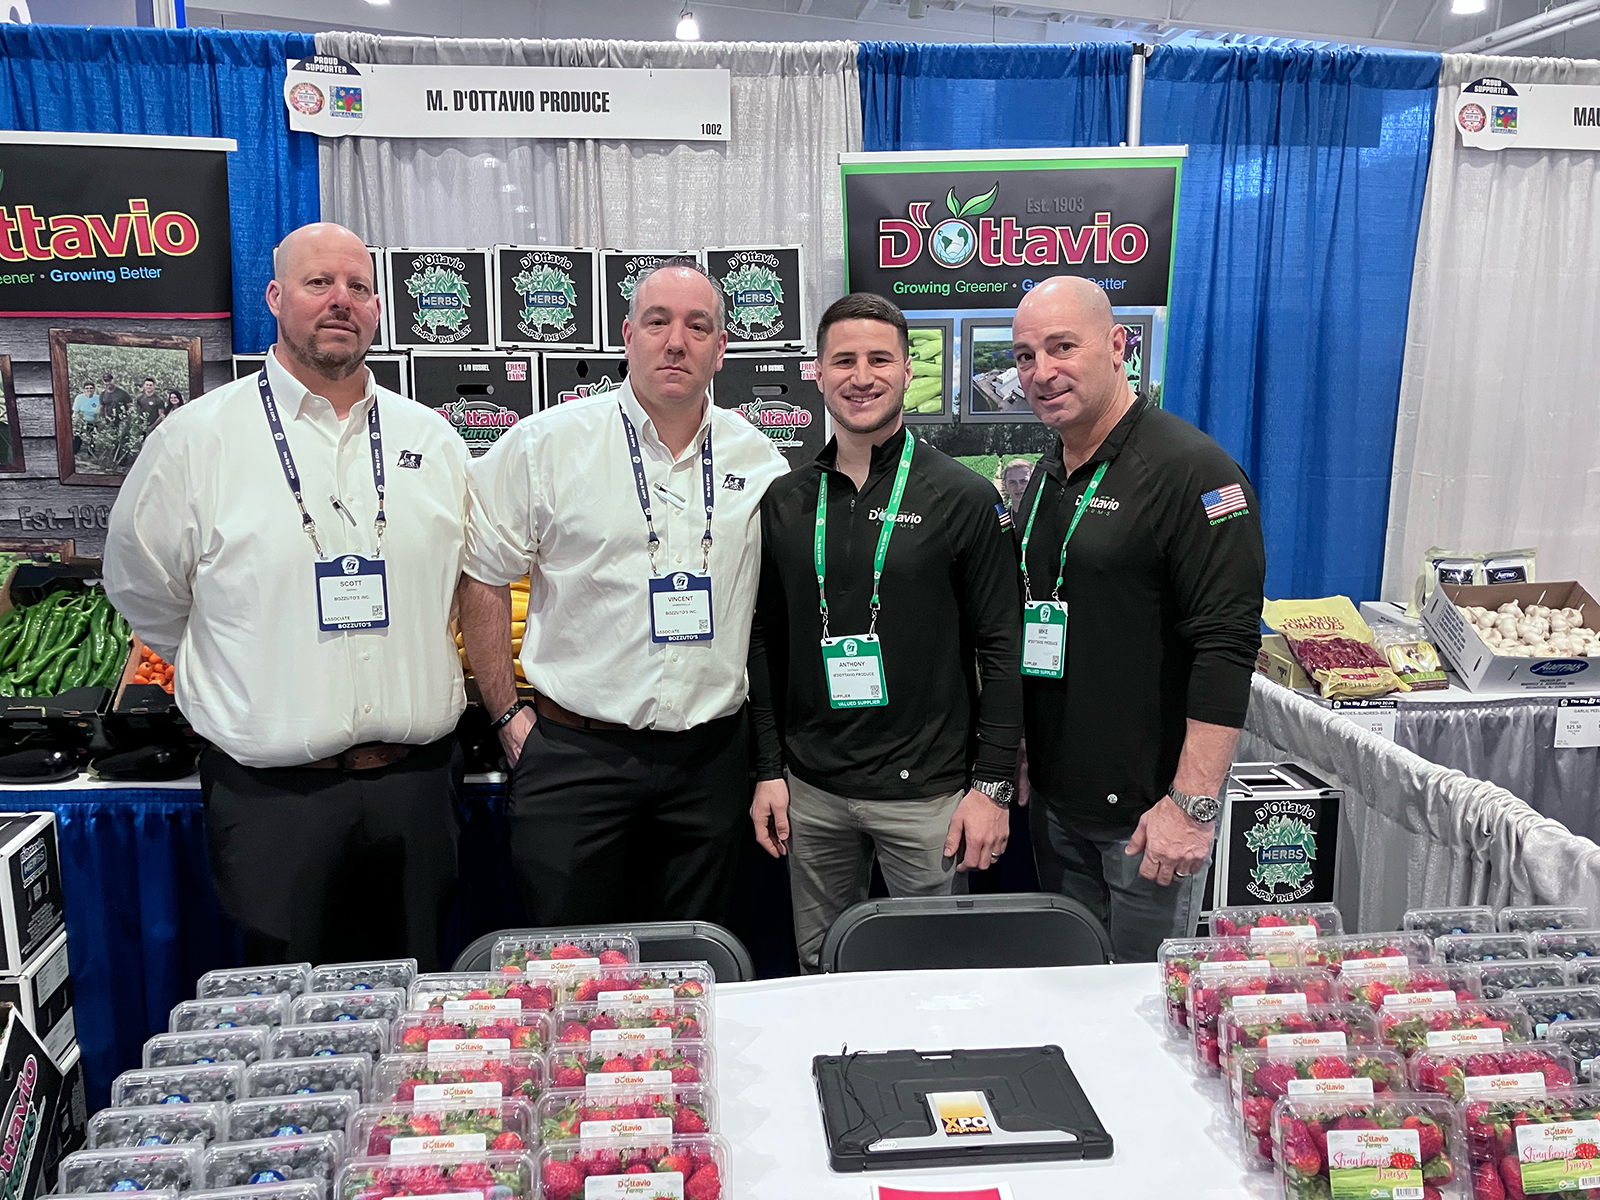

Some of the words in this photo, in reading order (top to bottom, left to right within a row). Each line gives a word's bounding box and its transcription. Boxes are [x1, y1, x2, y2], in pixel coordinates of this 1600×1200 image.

[305, 63, 348, 74] SUPPORTER
[314, 55, 338, 66] PROUD
[1474, 85, 1508, 94] SUPPORTER
[1482, 78, 1502, 86] PROUD
[426, 90, 448, 111] M.
[453, 90, 535, 112] D'OTTAVIO
[540, 91, 610, 113] PRODUCE
[700, 123, 722, 135] 1002
[1026, 197, 1050, 213] Est.
[1054, 197, 1085, 213] 1903
[412, 254, 466, 272] D'Ottavio
[520, 252, 573, 270] D'Ottavio
[728, 252, 780, 269] D'Ottavio
[50, 268, 116, 283] Growing
[120, 266, 162, 280] Better
[893, 281, 950, 296] Growing
[955, 279, 1008, 293] Greener
[422, 296, 459, 306] HERBS
[529, 295, 565, 305] HERBS
[737, 294, 772, 304] HERBS
[411, 324, 436, 342] SIMPLY
[438, 335, 454, 344] THE
[454, 324, 472, 341] BEST
[517, 322, 542, 341] SIMPLY
[544, 333, 558, 342] THE
[559, 324, 578, 340] BEST
[726, 322, 752, 340] SIMPLY
[752, 331, 766, 340] THE
[766, 320, 785, 338] BEST
[18, 505, 64, 531] Est.
[1279, 622, 1345, 630] TOMATOES
[1254, 801, 1316, 821] D'Ottavio
[1262, 849, 1304, 860] HERBS
[1246, 882, 1275, 902] SIMPLY
[1276, 893, 1294, 903] THE
[1294, 880, 1315, 899] BEST
[943, 1117, 988, 1132] XPO
[1333, 1151, 1392, 1168] Strawberries
